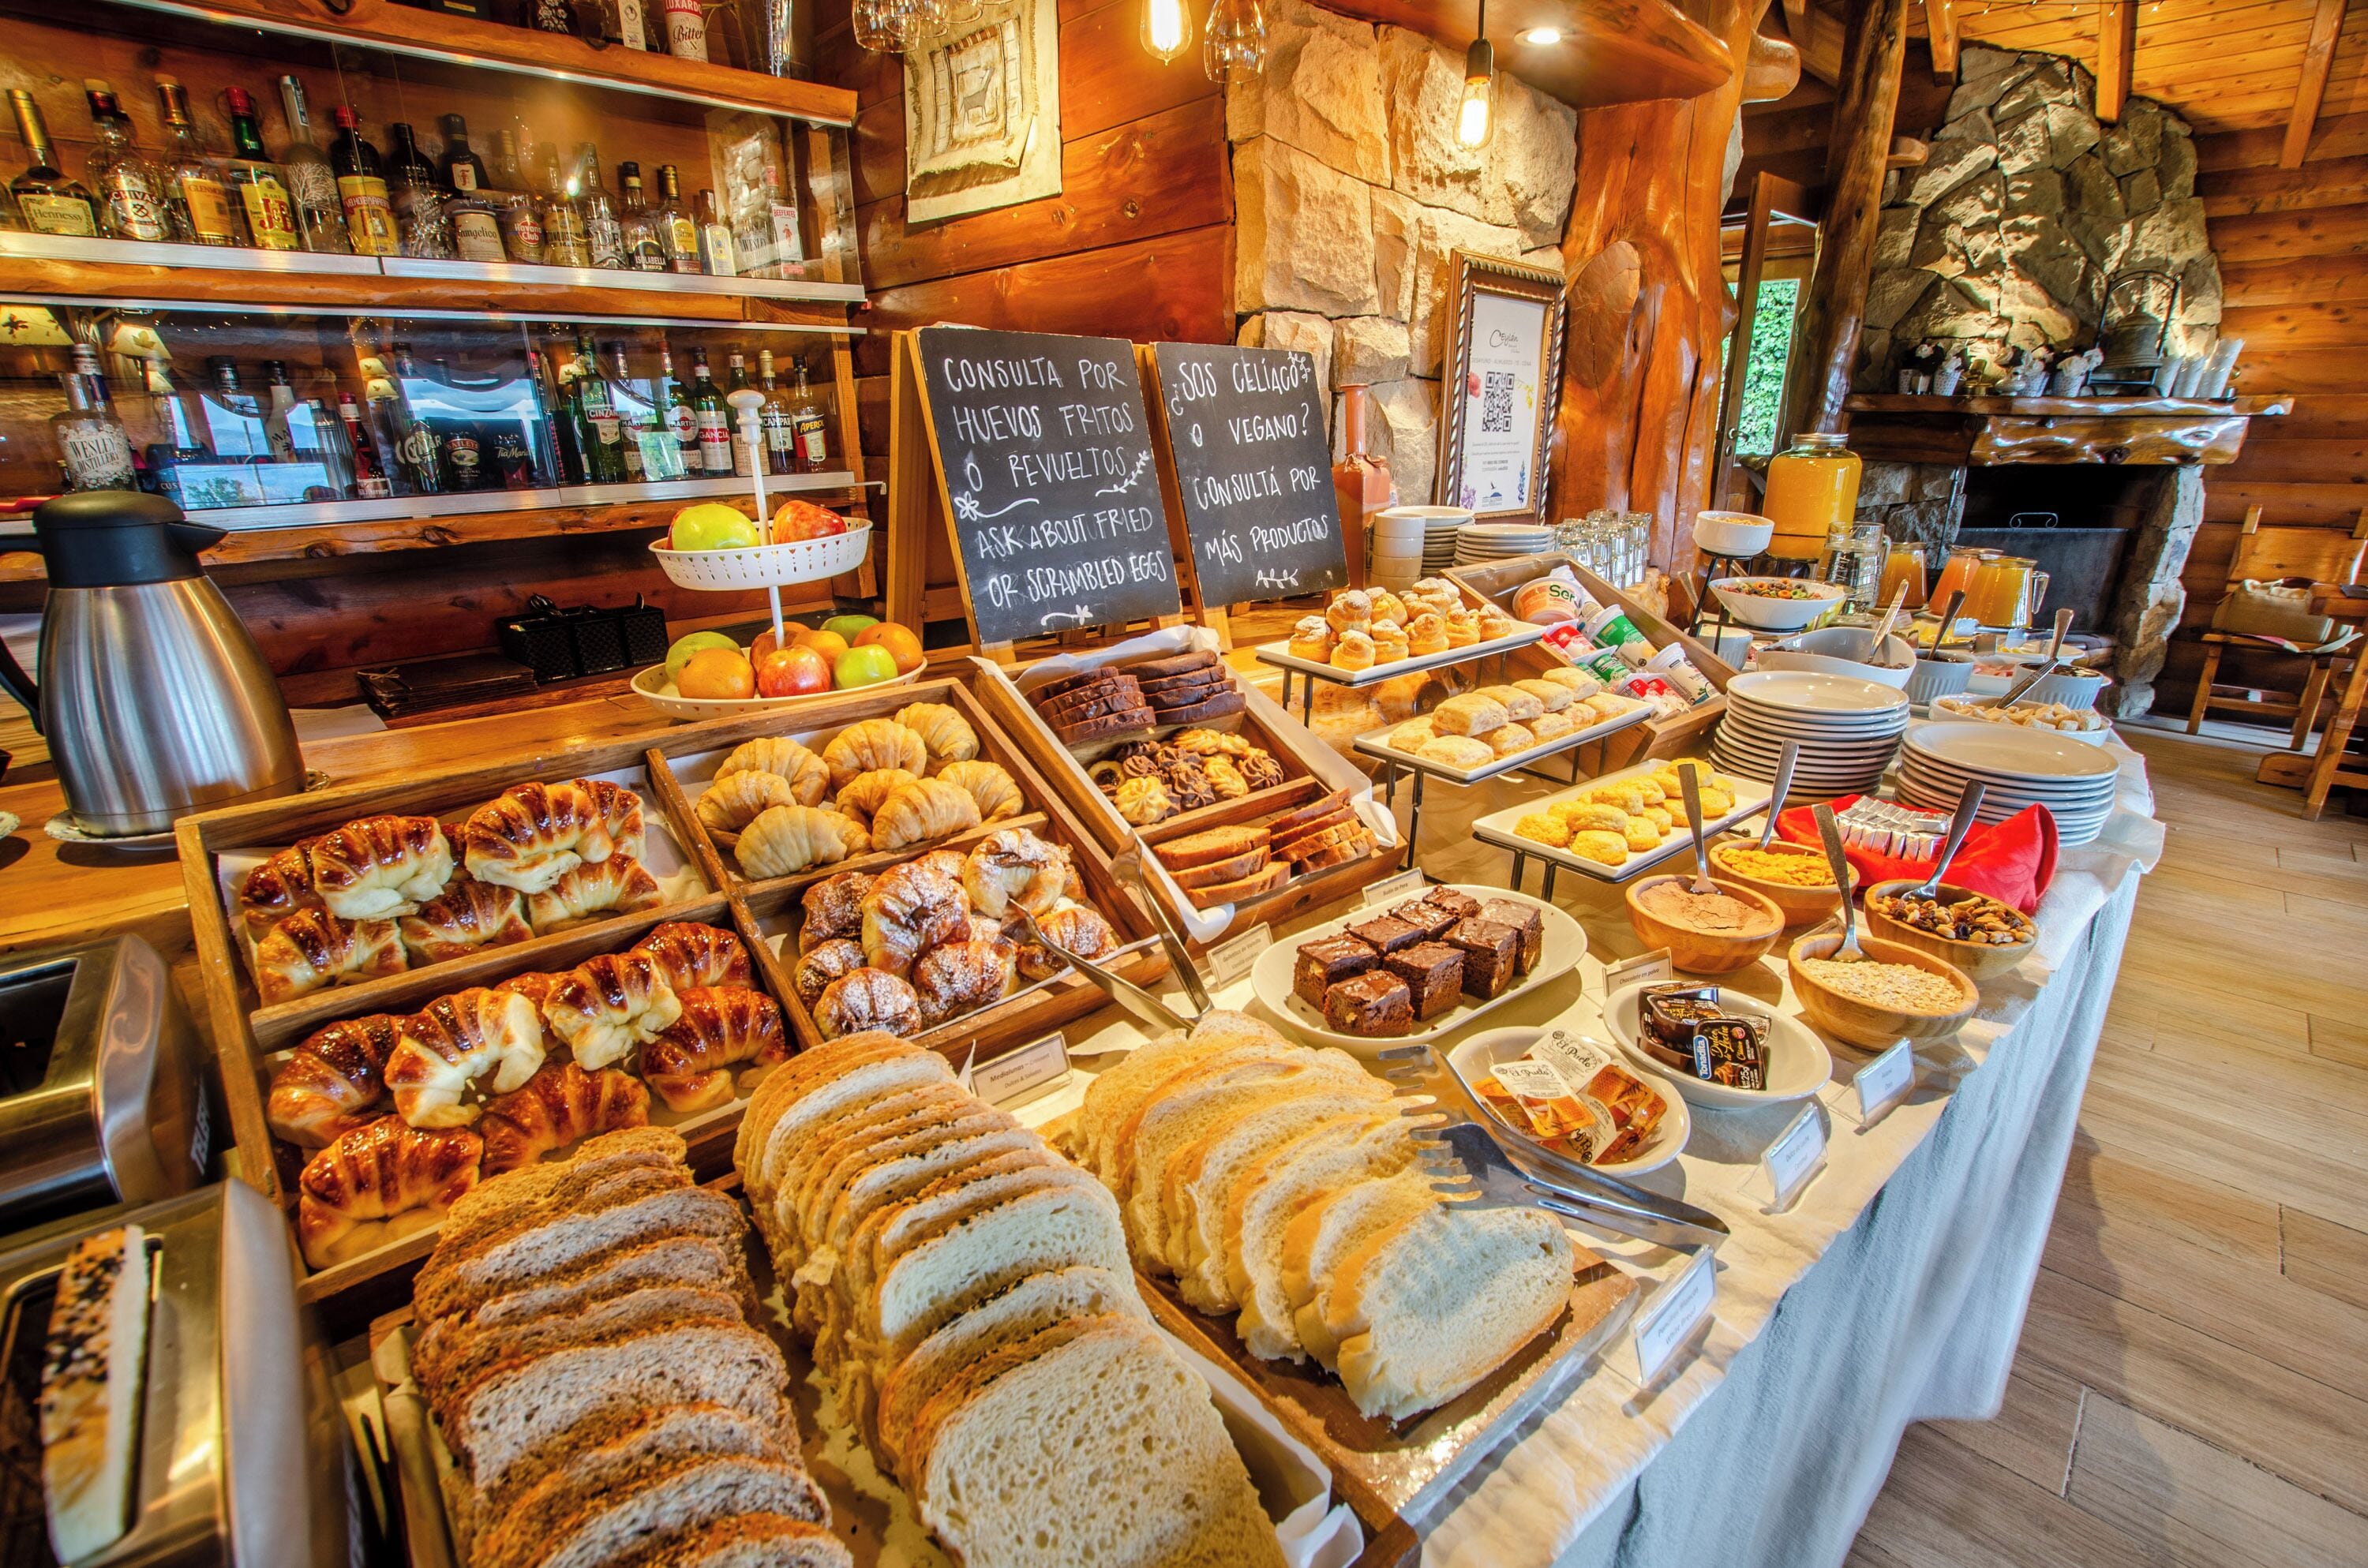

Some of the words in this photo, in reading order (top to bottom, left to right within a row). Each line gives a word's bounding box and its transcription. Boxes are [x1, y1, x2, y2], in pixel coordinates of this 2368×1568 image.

[673, 25, 703, 44] Bitter
[111, 191, 159, 205] CHIVAS
[33, 208, 83, 222] Hennessy
[774, 209, 796, 219] BEEFEATER
[515, 223, 542, 234] Havana
[522, 232, 540, 241] Club
[635, 255, 666, 266] ISOLABELLA
[944, 357, 1064, 392] CONSULTA
[1078, 359, 1128, 391] POR
[589, 410, 620, 418] CINZAN
[952, 405, 1042, 443] HUEVOS
[1058, 401, 1135, 436] FRITOS
[445, 440, 479, 450] BAILEYS
[699, 429, 729, 440] GANCIA
[1191, 423, 1203, 447] O
[69, 436, 117, 459] WESLEY
[77, 451, 119, 473] DISTILLERY
[966, 462, 984, 492] O
[1008, 447, 1126, 488] REVUELTOS
[1194, 465, 1282, 510] CONSULTÁ
[1290, 466, 1321, 492] POR
[976, 525, 1024, 559] ASK
[1030, 513, 1088, 549] ABOUT
[1094, 507, 1153, 540] FRIED
[1205, 530, 1243, 567] MÁS
[1250, 514, 1329, 552] PRODUCTOS
[988, 574, 1018, 608] OR
[1026, 558, 1126, 602] SCRAMBLED
[1130, 550, 1167, 583] EGGS
[1619, 973, 1641, 985] Chocolate
[1556, 1038, 1569, 1050] El
[1564, 1046, 1591, 1068] Puelo
[1708, 1028, 1723, 1058] Dulce
[1696, 1038, 1709, 1076] Tonadita
[990, 1063, 1025, 1083] Medialunas
